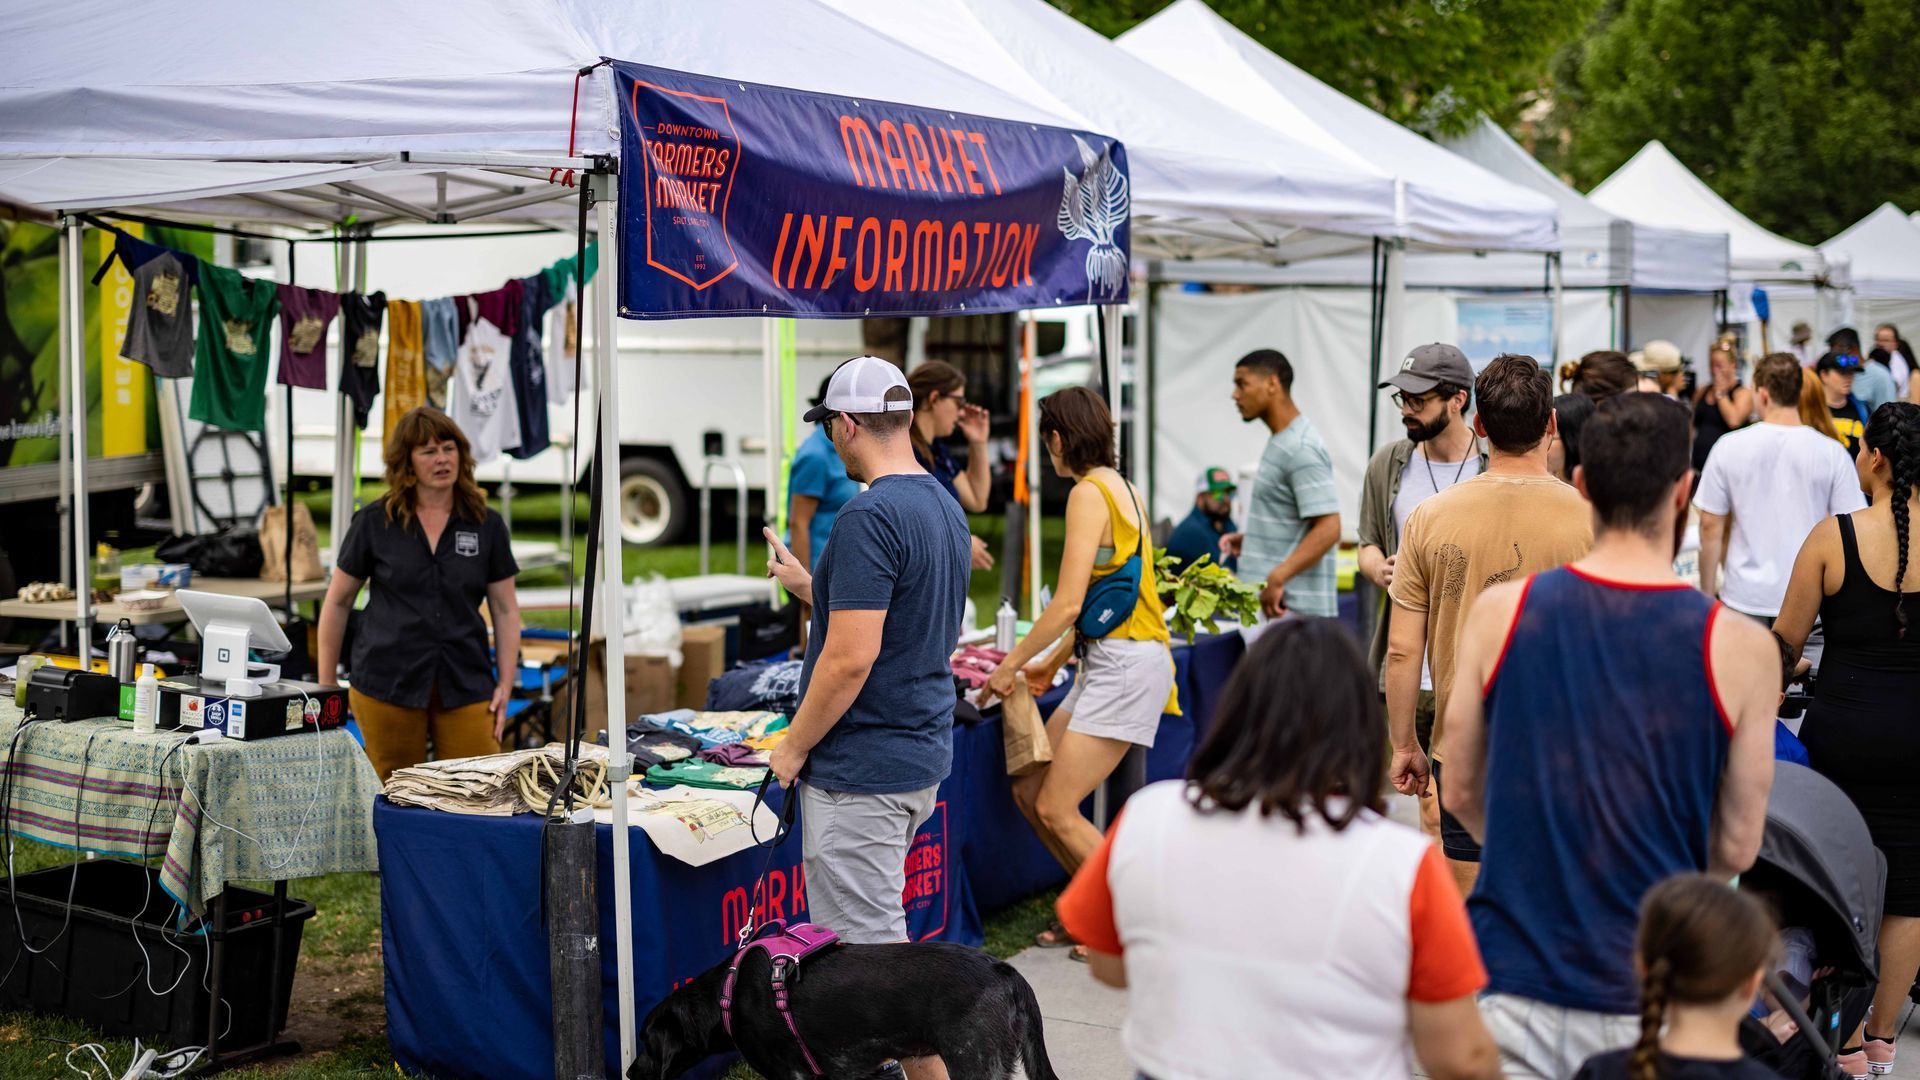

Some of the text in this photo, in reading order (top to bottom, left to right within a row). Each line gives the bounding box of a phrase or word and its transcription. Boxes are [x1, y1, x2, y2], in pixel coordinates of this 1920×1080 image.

[657, 122, 719, 140] DOWNTOWN
[839, 114, 1002, 196] MARKET
[655, 175, 722, 214] MARKET
[673, 216, 687, 225] SALT
[772, 212, 1041, 293] INFORMATION
